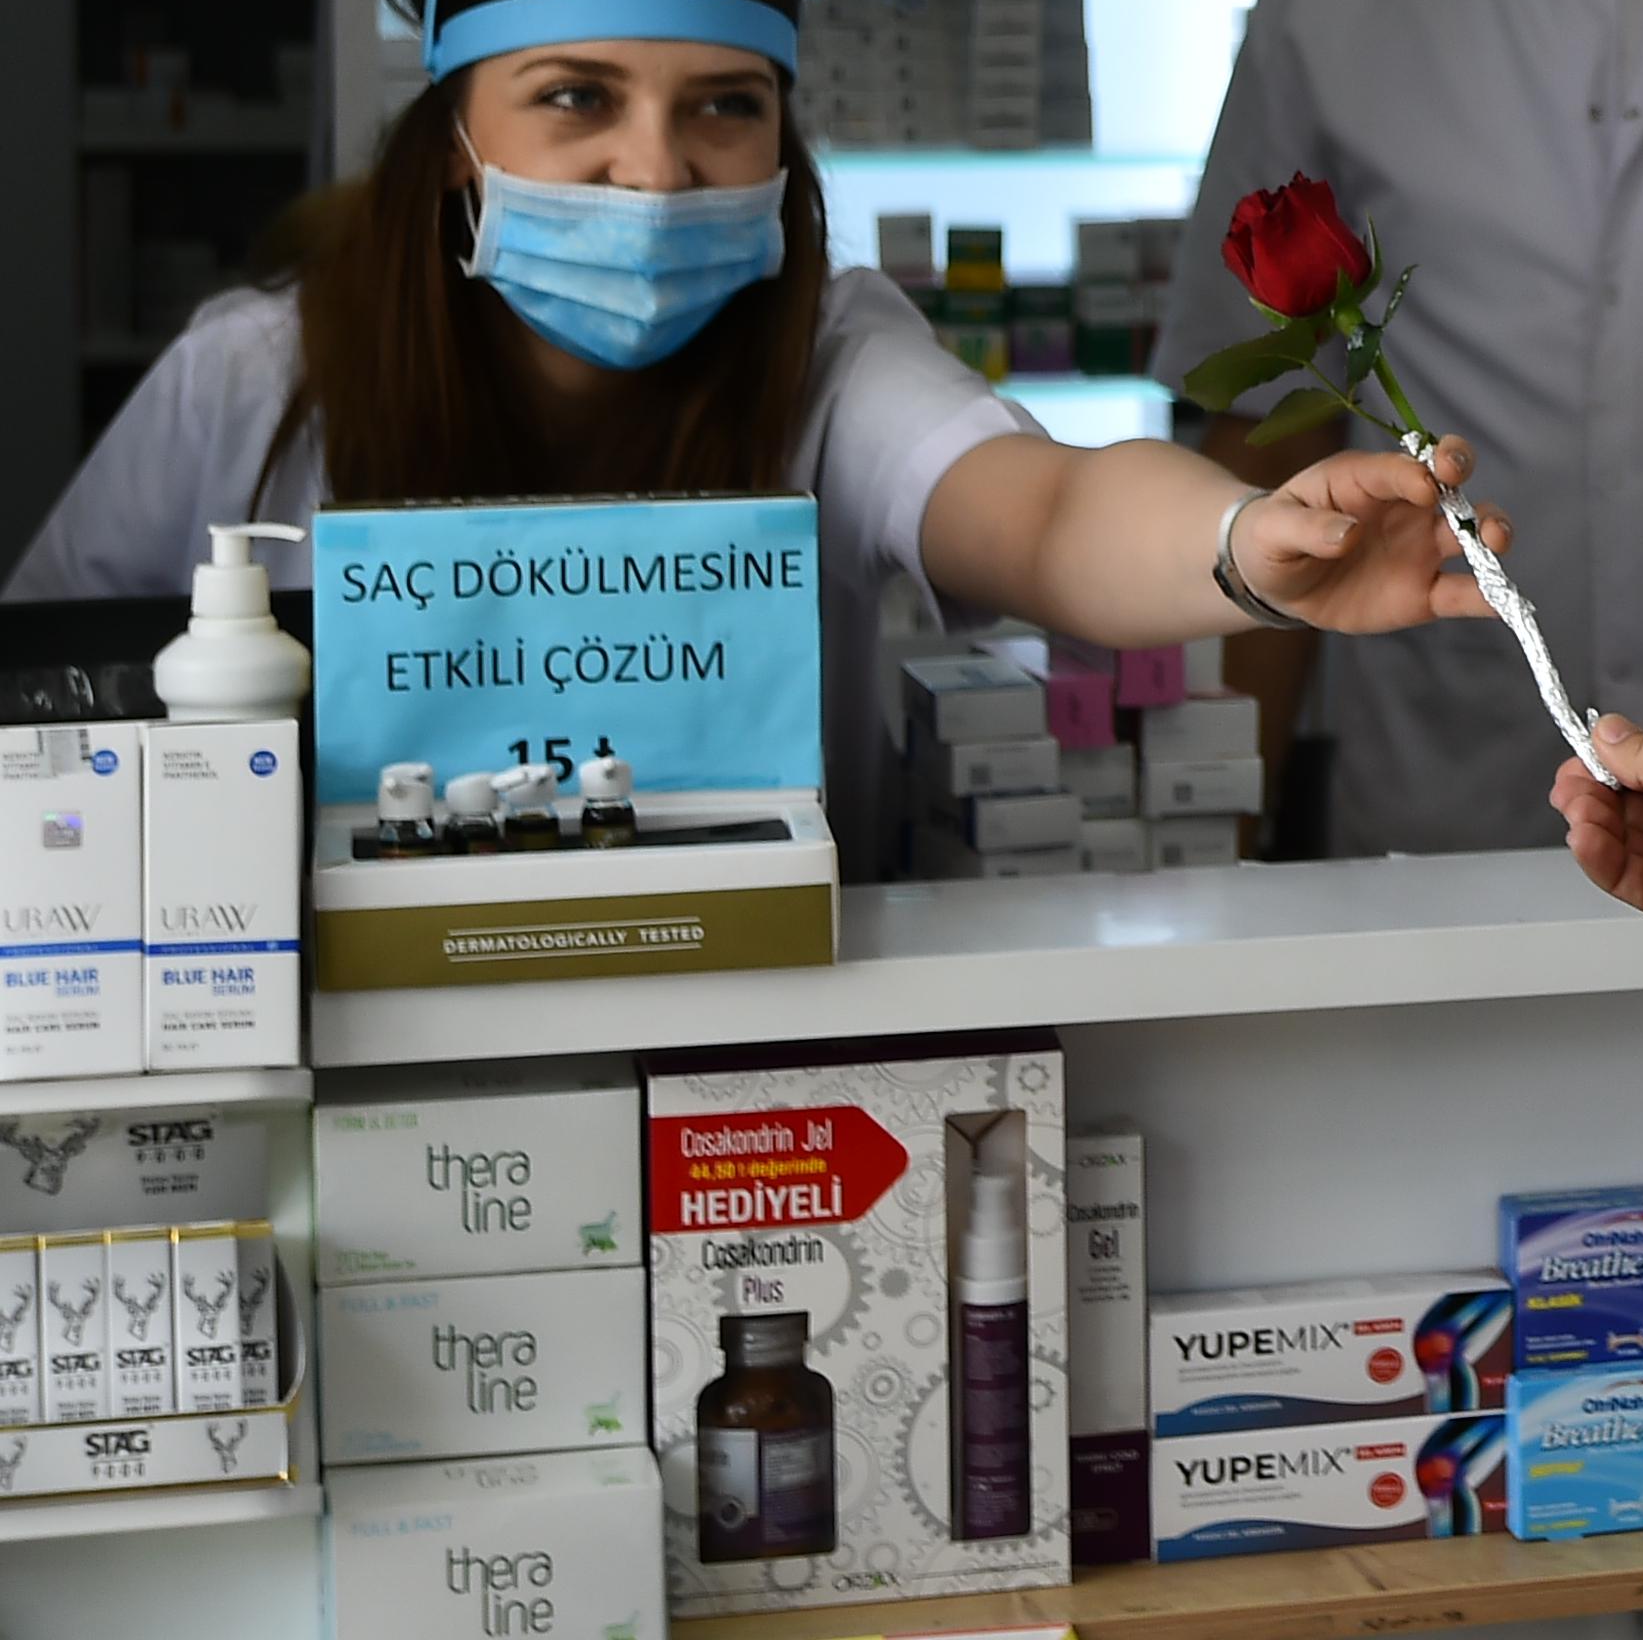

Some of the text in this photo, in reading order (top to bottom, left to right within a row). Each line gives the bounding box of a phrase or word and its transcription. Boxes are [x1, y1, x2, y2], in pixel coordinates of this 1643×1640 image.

[342, 543, 804, 610] SAÇ DÖKÜLMESİNE
[386, 633, 725, 694] ETKİLİ ÇÖZÜM
[640, 924, 704, 944] TESTED
[6, 968, 99, 986] BLUE HAIR
[163, 968, 255, 985] BLUE HAIR
[128, 1120, 213, 1147] STAG
[681, 1175, 842, 1225] HEDİYELİ
[51, 1352, 100, 1374] STAG
[117, 1348, 165, 1369] STAG
[186, 1344, 236, 1366] STAG
[85, 1430, 151, 1457] STAG
